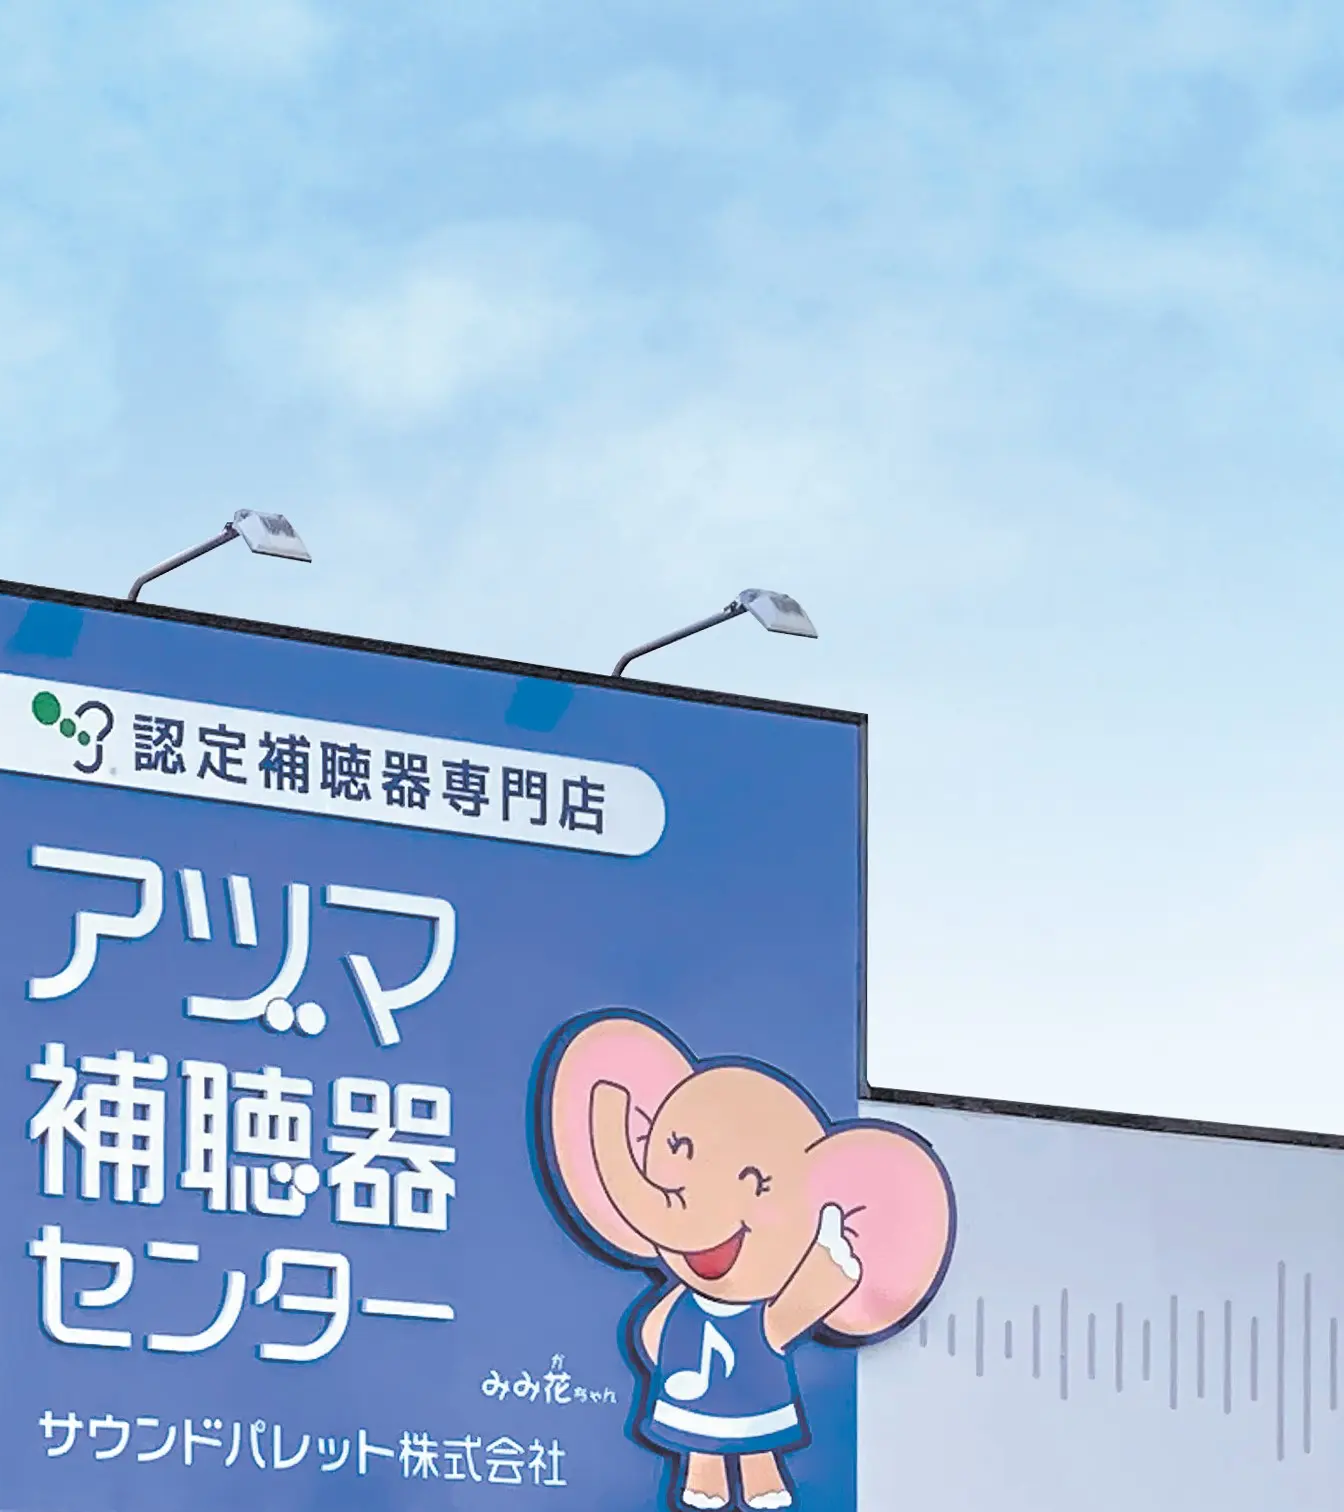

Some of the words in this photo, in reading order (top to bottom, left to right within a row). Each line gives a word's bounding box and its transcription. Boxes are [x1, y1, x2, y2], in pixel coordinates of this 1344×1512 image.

[132, 713, 607, 835] 認定補聴器専門店
[27, 843, 458, 1048] アヅマ
[28, 1041, 458, 1232] 補聴器
[28, 1224, 457, 1362] センター
[39, 1410, 568, 1488] サウンドパレット株式会社
[481, 1370, 618, 1405] みみ花ちゃん
